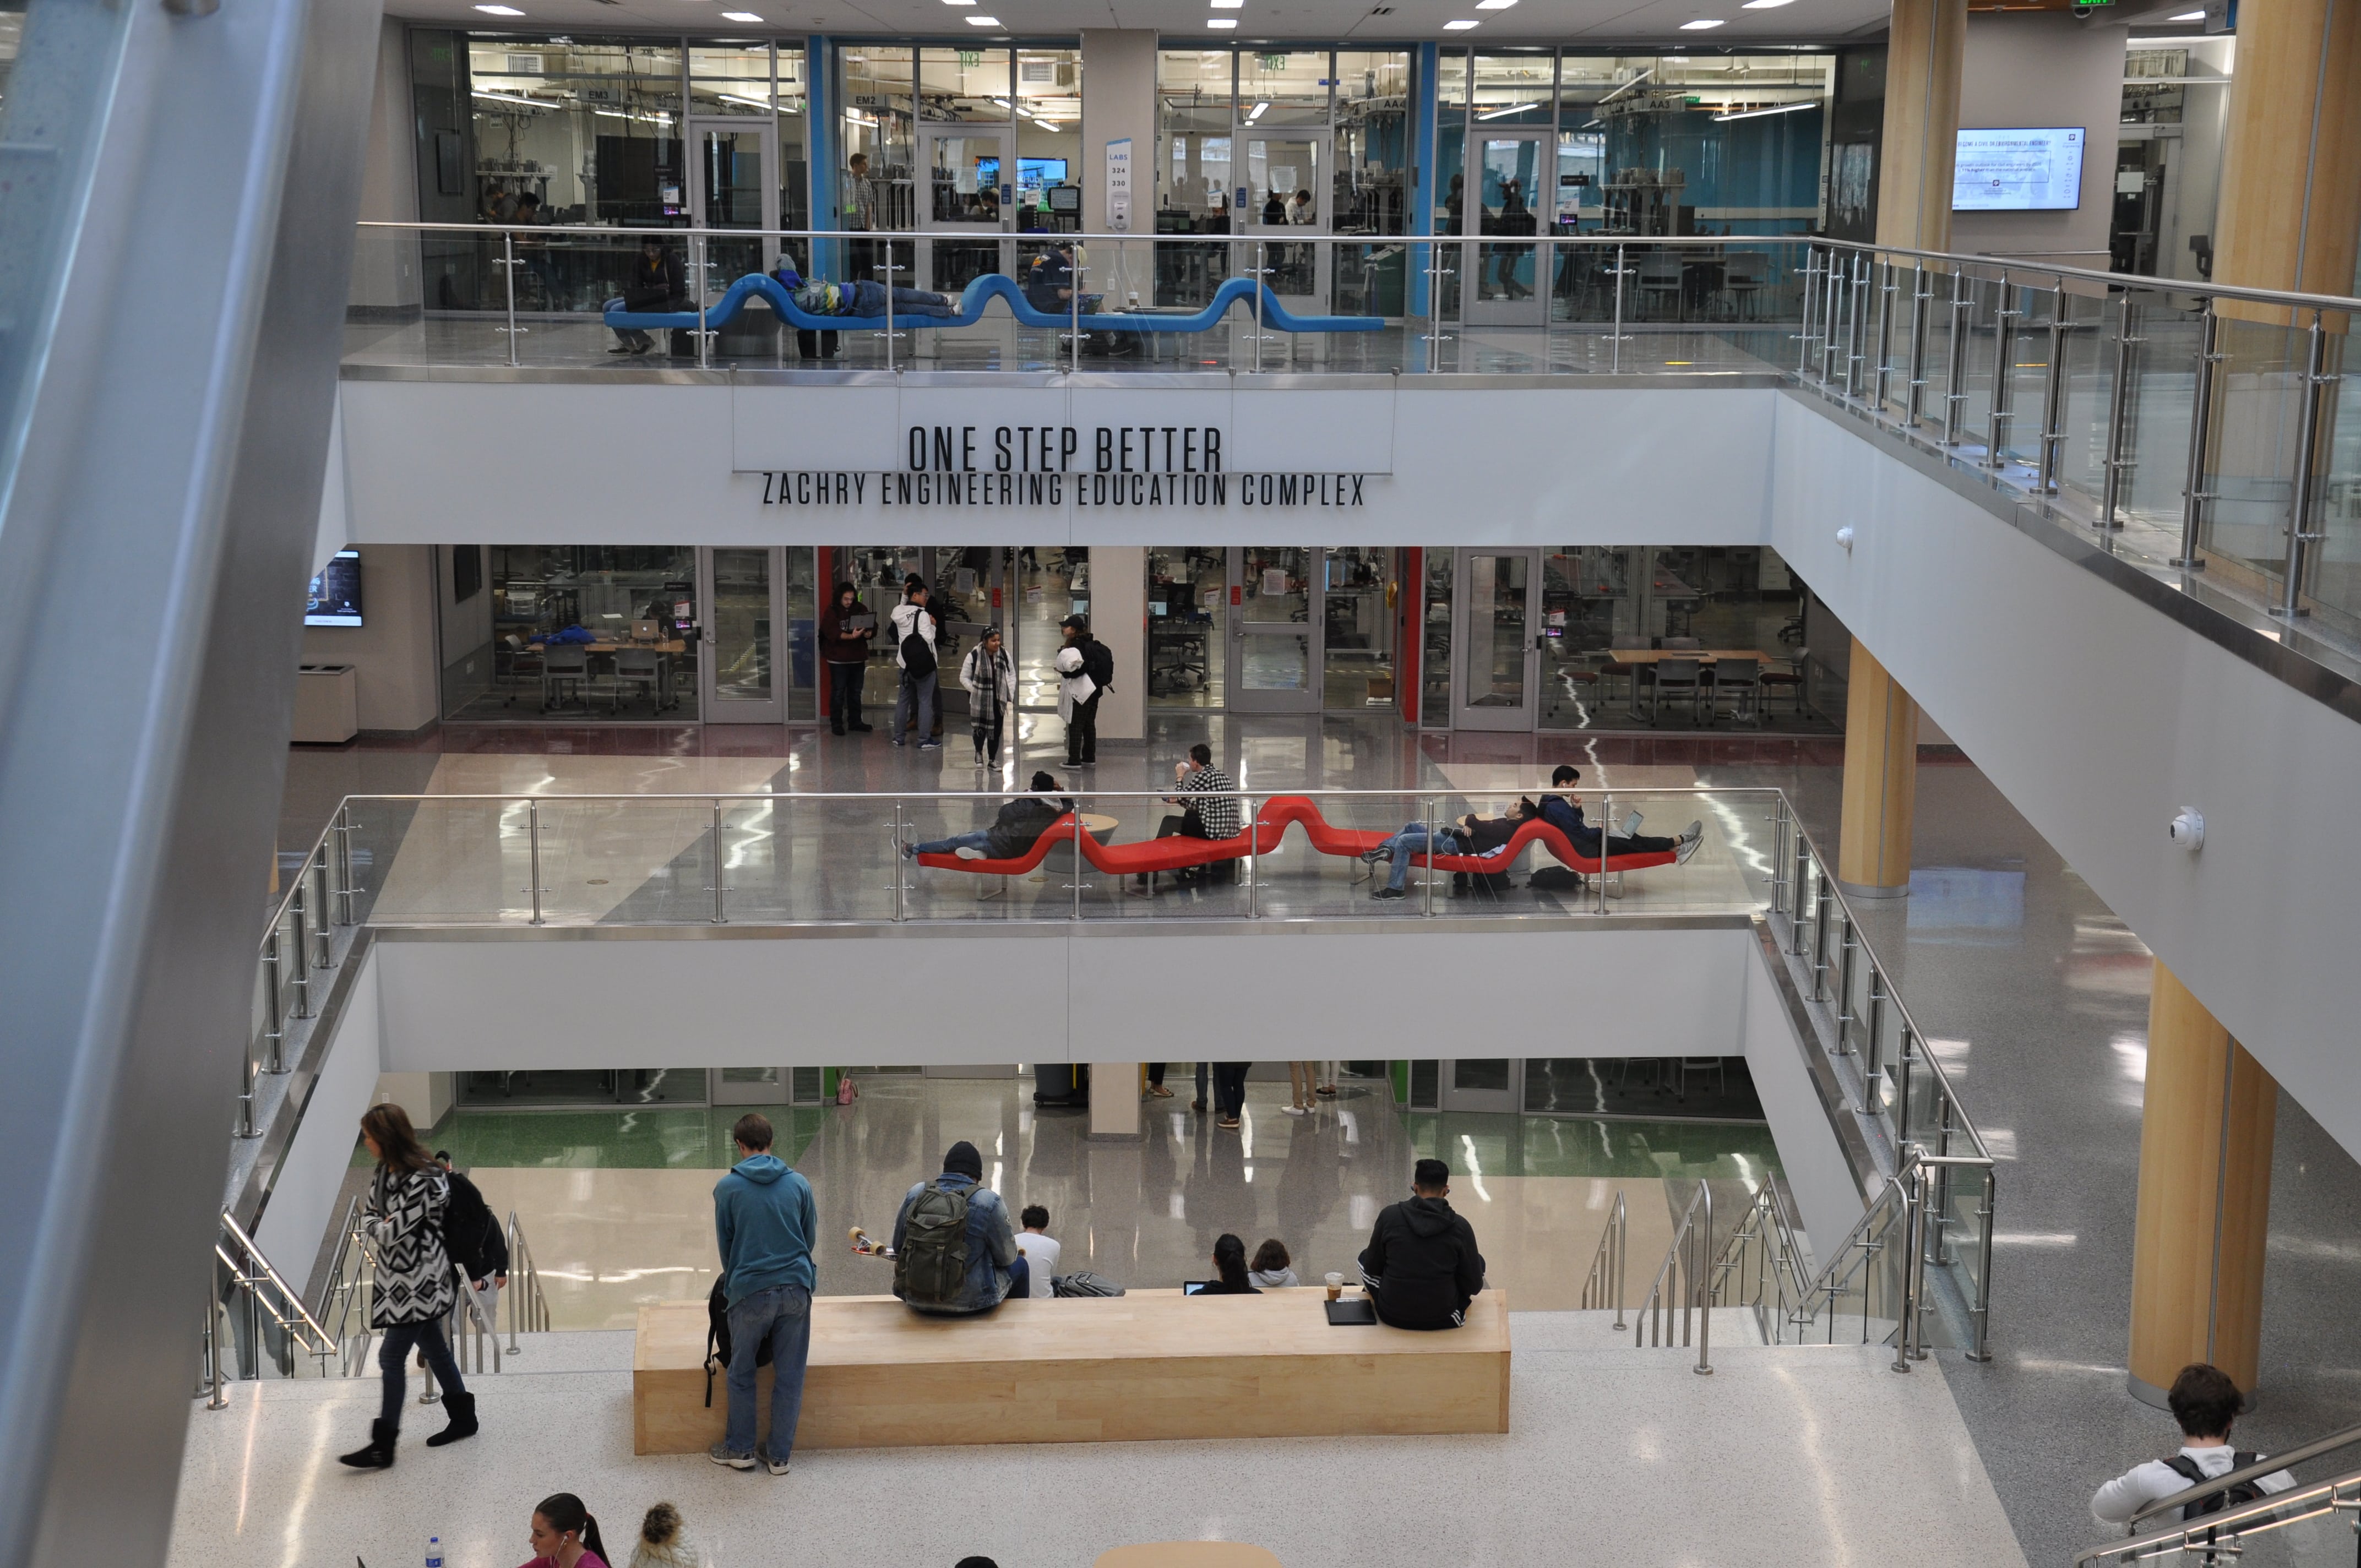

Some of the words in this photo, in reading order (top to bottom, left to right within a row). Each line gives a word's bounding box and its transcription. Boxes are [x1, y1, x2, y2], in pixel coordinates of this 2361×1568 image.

[588, 91, 608, 100] EM3
[856, 96, 876, 105] EM2
[1650, 100, 1670, 109] AA3
[909, 426, 976, 472] ONE
[995, 427, 1077, 472] STEP
[1096, 427, 1221, 473] BETTER
[763, 472, 866, 504] ZACHRY
[882, 473, 1062, 505] ENGINEERING
[1078, 474, 1226, 505] EDUCATION
[1242, 474, 1364, 506] COMPLEX
